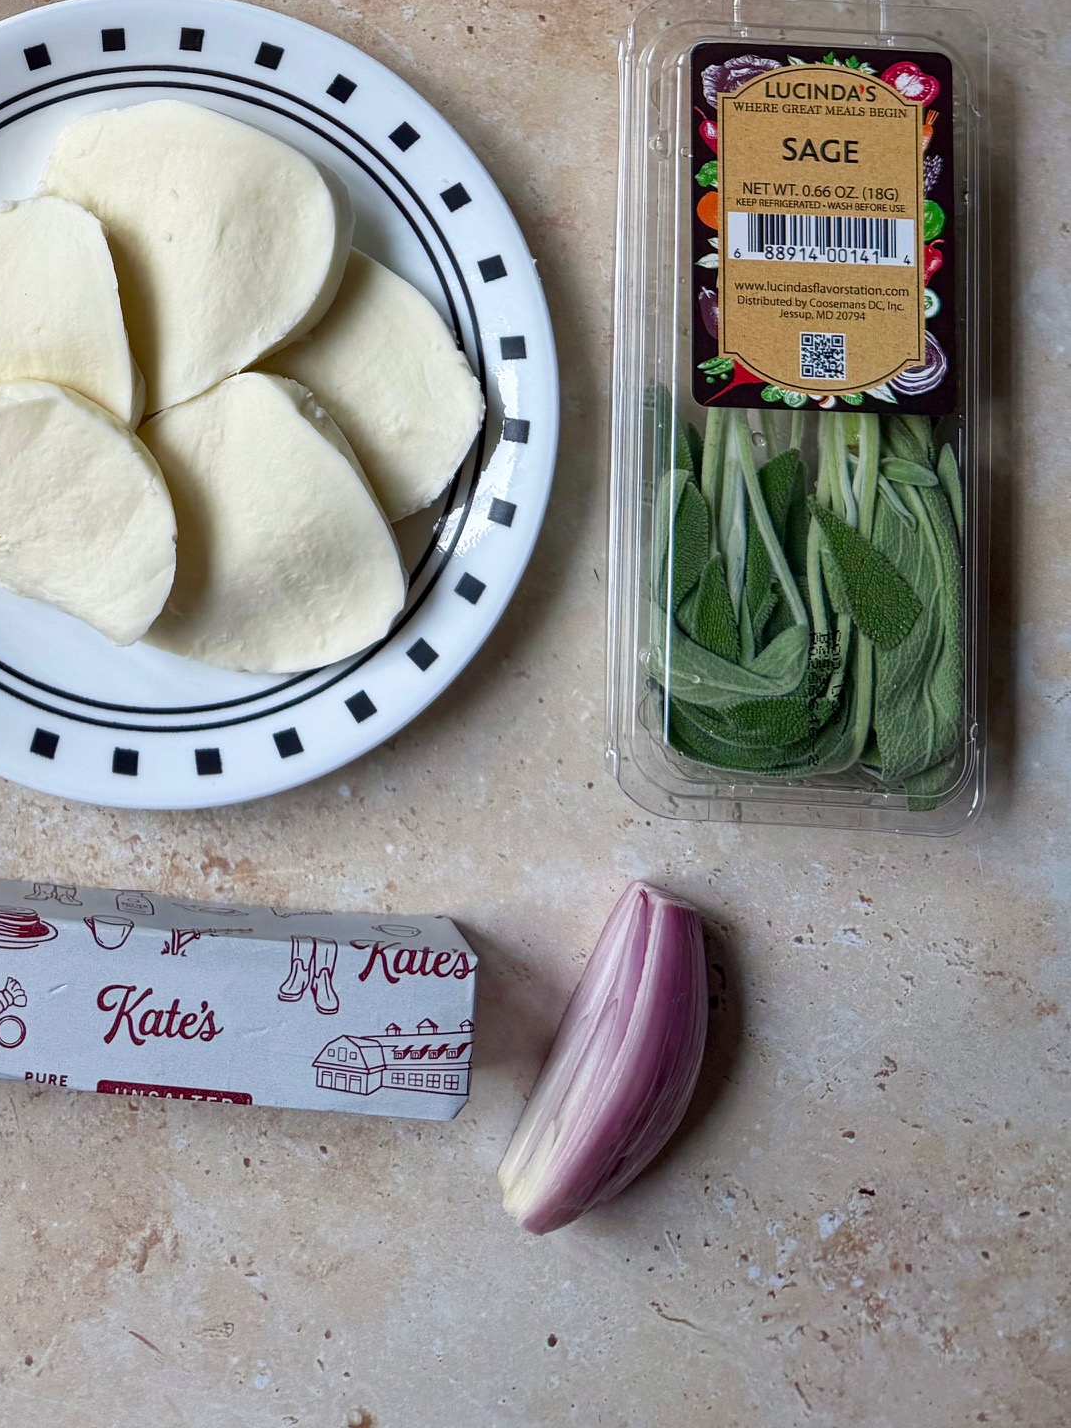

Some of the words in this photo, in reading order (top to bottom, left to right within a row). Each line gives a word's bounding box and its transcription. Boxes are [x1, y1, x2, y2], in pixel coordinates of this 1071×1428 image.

[765, 81, 876, 102] LUCINDA'S
[733, 101, 779, 113] WHERE
[782, 103, 822, 115] GREAT
[825, 106, 866, 117] MEALS
[869, 108, 908, 119] BEGIN
[781, 137, 859, 164] SAGE
[742, 181, 771, 195] NET
[773, 183, 799, 197] WT.
[802, 184, 831, 198] 0.66
[834, 185, 859, 199] OZ.
[862, 186, 899, 202] (18G)
[735, 198, 757, 207] KEEP
[759, 199, 821, 210] REFRIGERATED
[827, 202, 853, 211] WASH
[855, 203, 887, 212] BEFORE
[888, 204, 906, 213] USE
[733, 248, 741, 259] 6
[764, 246, 818, 261] 88914
[827, 248, 879, 264] 00141
[903, 255, 911, 265] 4
[734, 280, 909, 297] www.lucindasflavorstation.com
[737, 295, 792, 307] Distributed
[794, 298, 807, 309] by
[809, 298, 866, 310] Coosemans
[868, 301, 885, 312] DC,
[887, 302, 905, 312] Inc.
[779, 309, 814, 321] Jessup,
[816, 311, 833, 320] MD
[836, 311, 866, 321] 20794
[349, 939, 478, 984] Kate's
[96, 984, 224, 1046] Kate's
[24, 1071, 69, 1088] PURE
